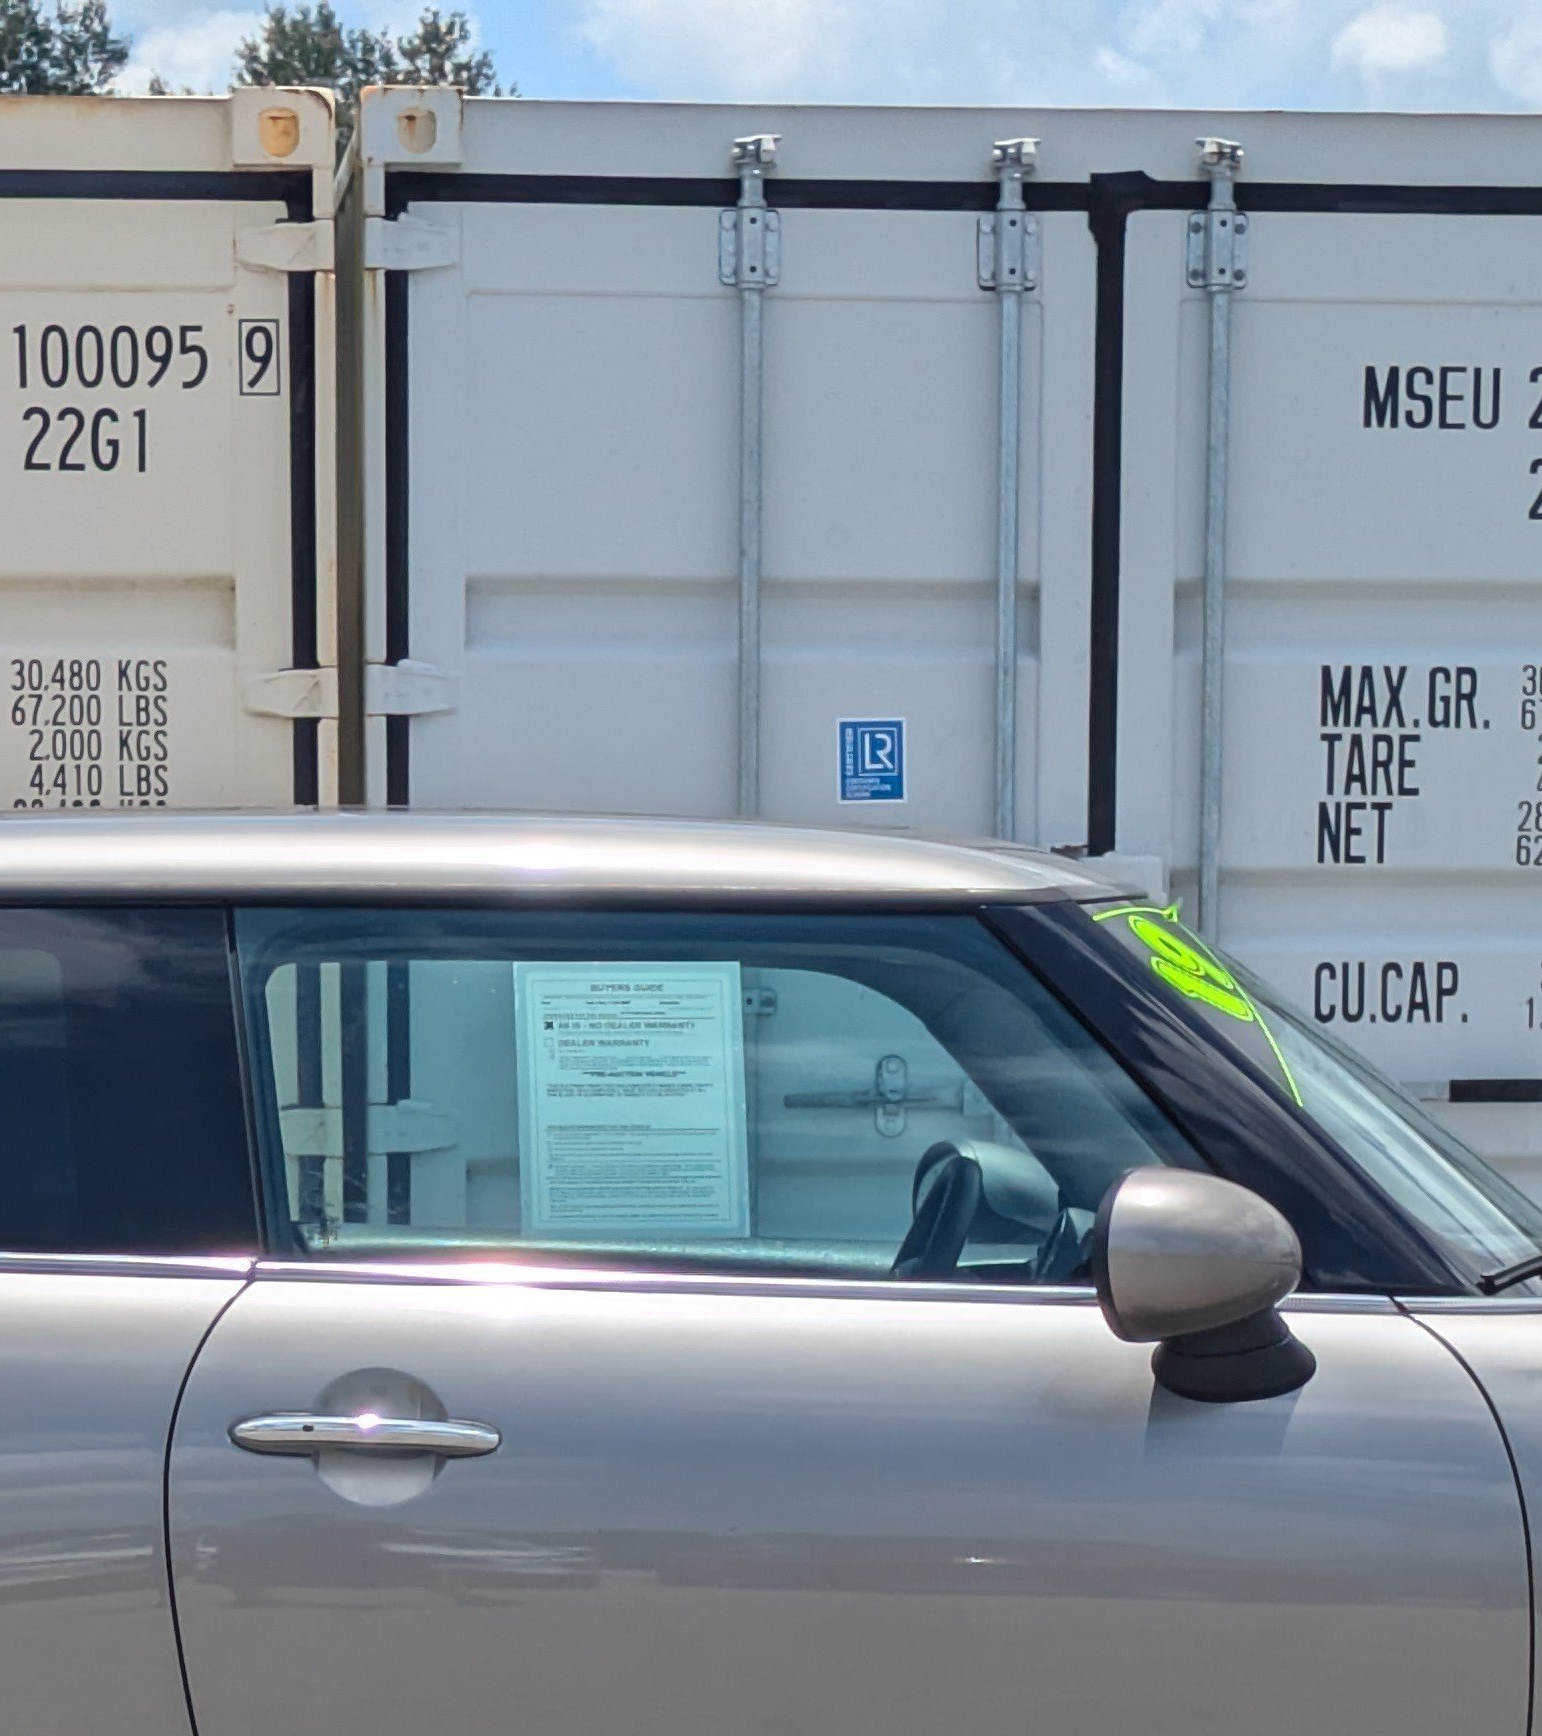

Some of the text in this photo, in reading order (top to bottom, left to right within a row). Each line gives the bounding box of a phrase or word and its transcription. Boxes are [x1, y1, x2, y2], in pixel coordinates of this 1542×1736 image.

[13, 325, 207, 389] 100095
[246, 326, 273, 388] 9
[1364, 366, 1500, 429] MSEU
[23, 407, 145, 472] 22G1
[118, 660, 167, 691] KGS
[119, 695, 167, 727] LBS
[120, 730, 167, 761] KGS
[864, 733, 894, 770] LR
[1320, 733, 1420, 796] TARE
[120, 764, 168, 796] LBS
[1318, 802, 1393, 863] NET
